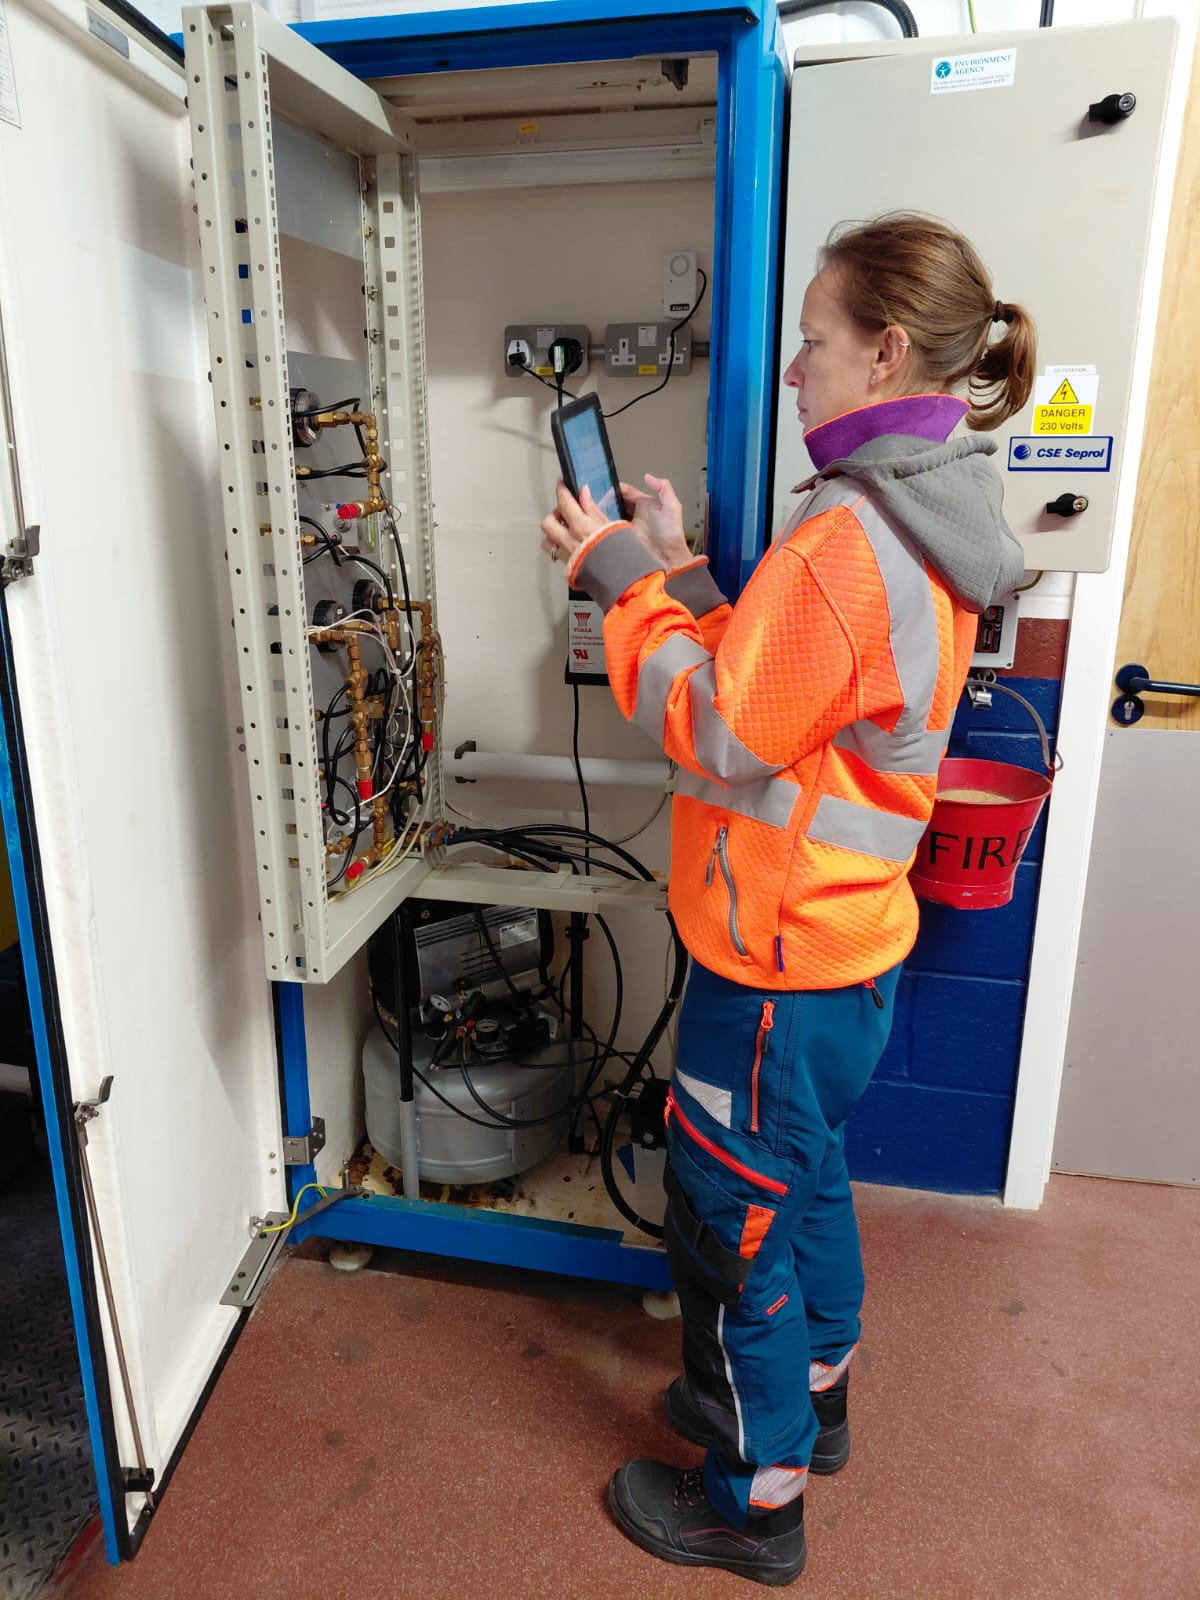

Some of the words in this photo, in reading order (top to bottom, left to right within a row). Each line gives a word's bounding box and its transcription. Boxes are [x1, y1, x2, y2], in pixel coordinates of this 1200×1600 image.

[954, 55, 1012, 68] ENVIRONMENT
[954, 66, 984, 76] AGENCY
[1040, 408, 1086, 418] DANGER
[1039, 422, 1058, 431] 230
[1059, 422, 1084, 431] Volts
[1036, 448, 1063, 458] CSE
[1064, 447, 1105, 460] Seprol
